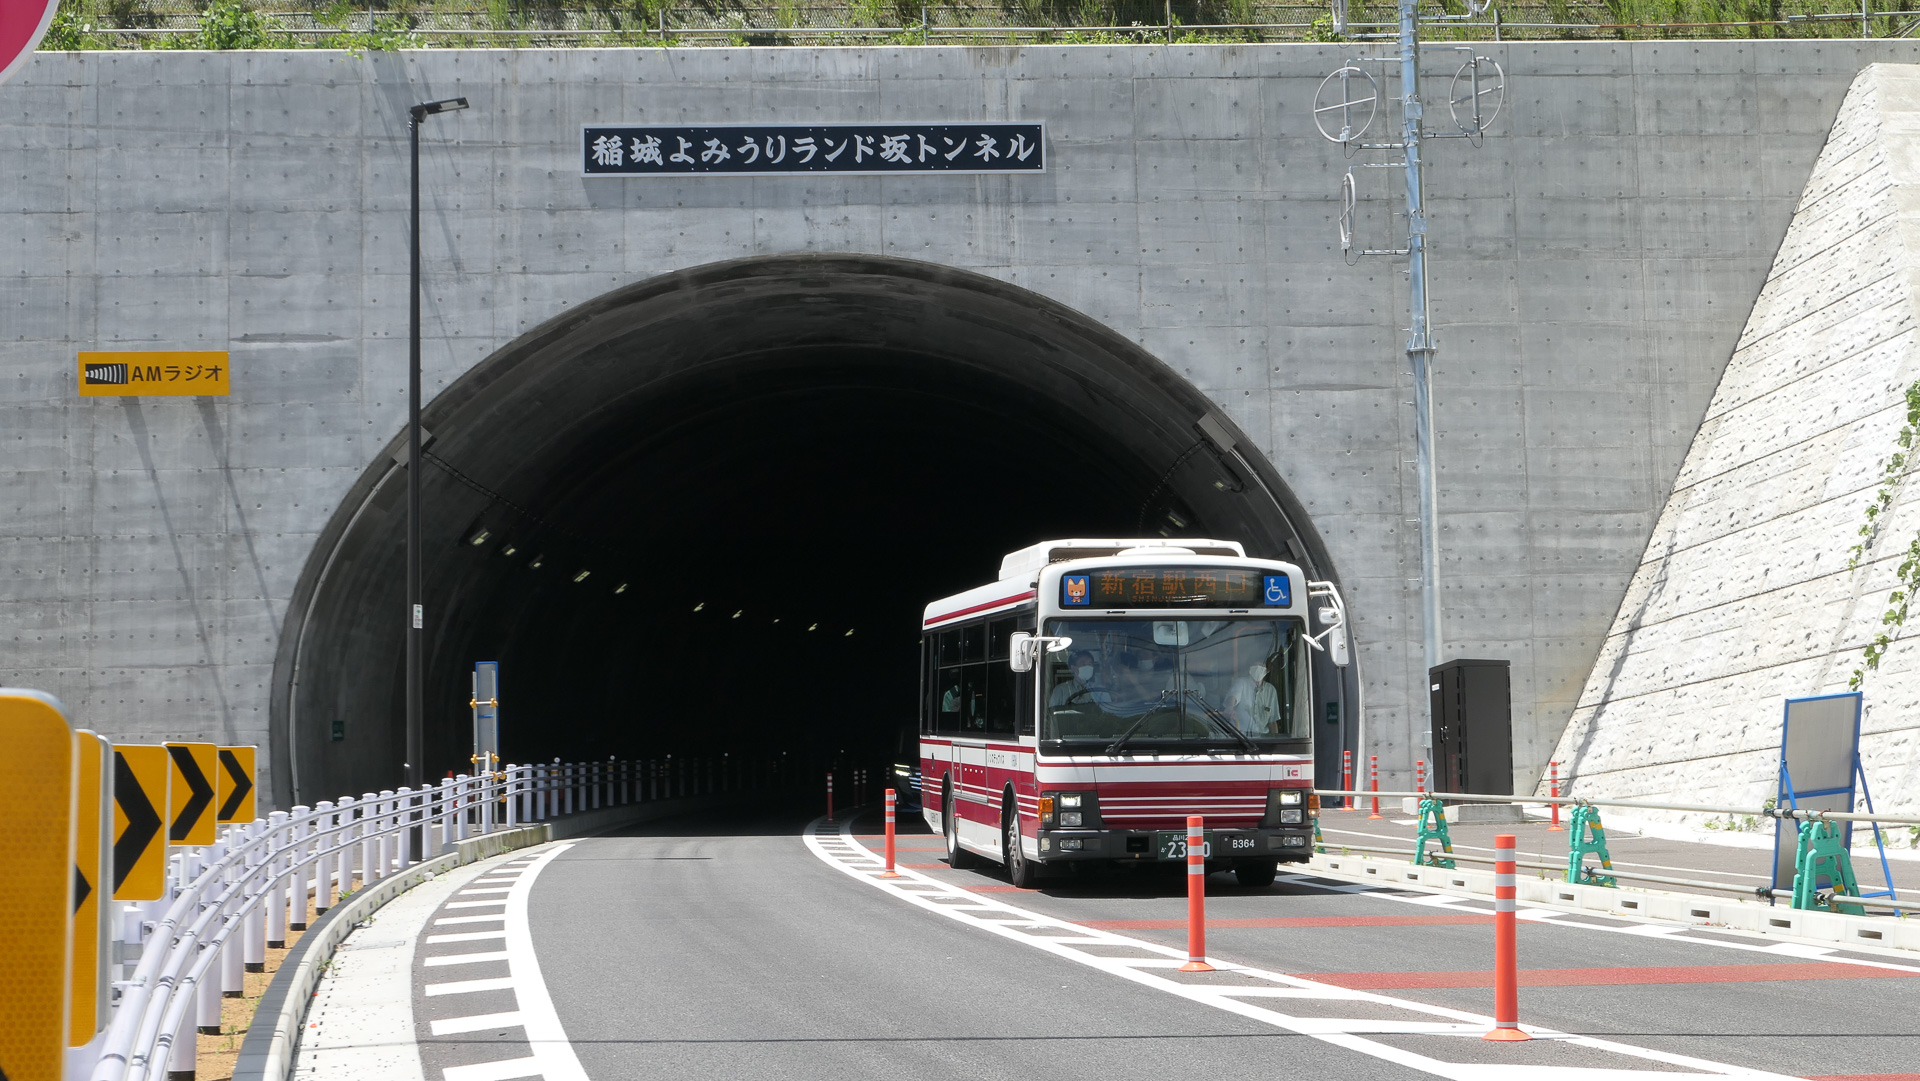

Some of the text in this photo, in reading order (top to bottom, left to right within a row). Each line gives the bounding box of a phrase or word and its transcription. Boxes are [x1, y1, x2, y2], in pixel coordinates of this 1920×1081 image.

[591, 133, 1035, 167] 稲城よみうりランド坂トンネル
[131, 364, 223, 382] AMラジオ
[1101, 570, 1246, 595] 新宿駅西口
[1167, 841, 1211, 858] 230
[1232, 839, 1255, 849] B364
